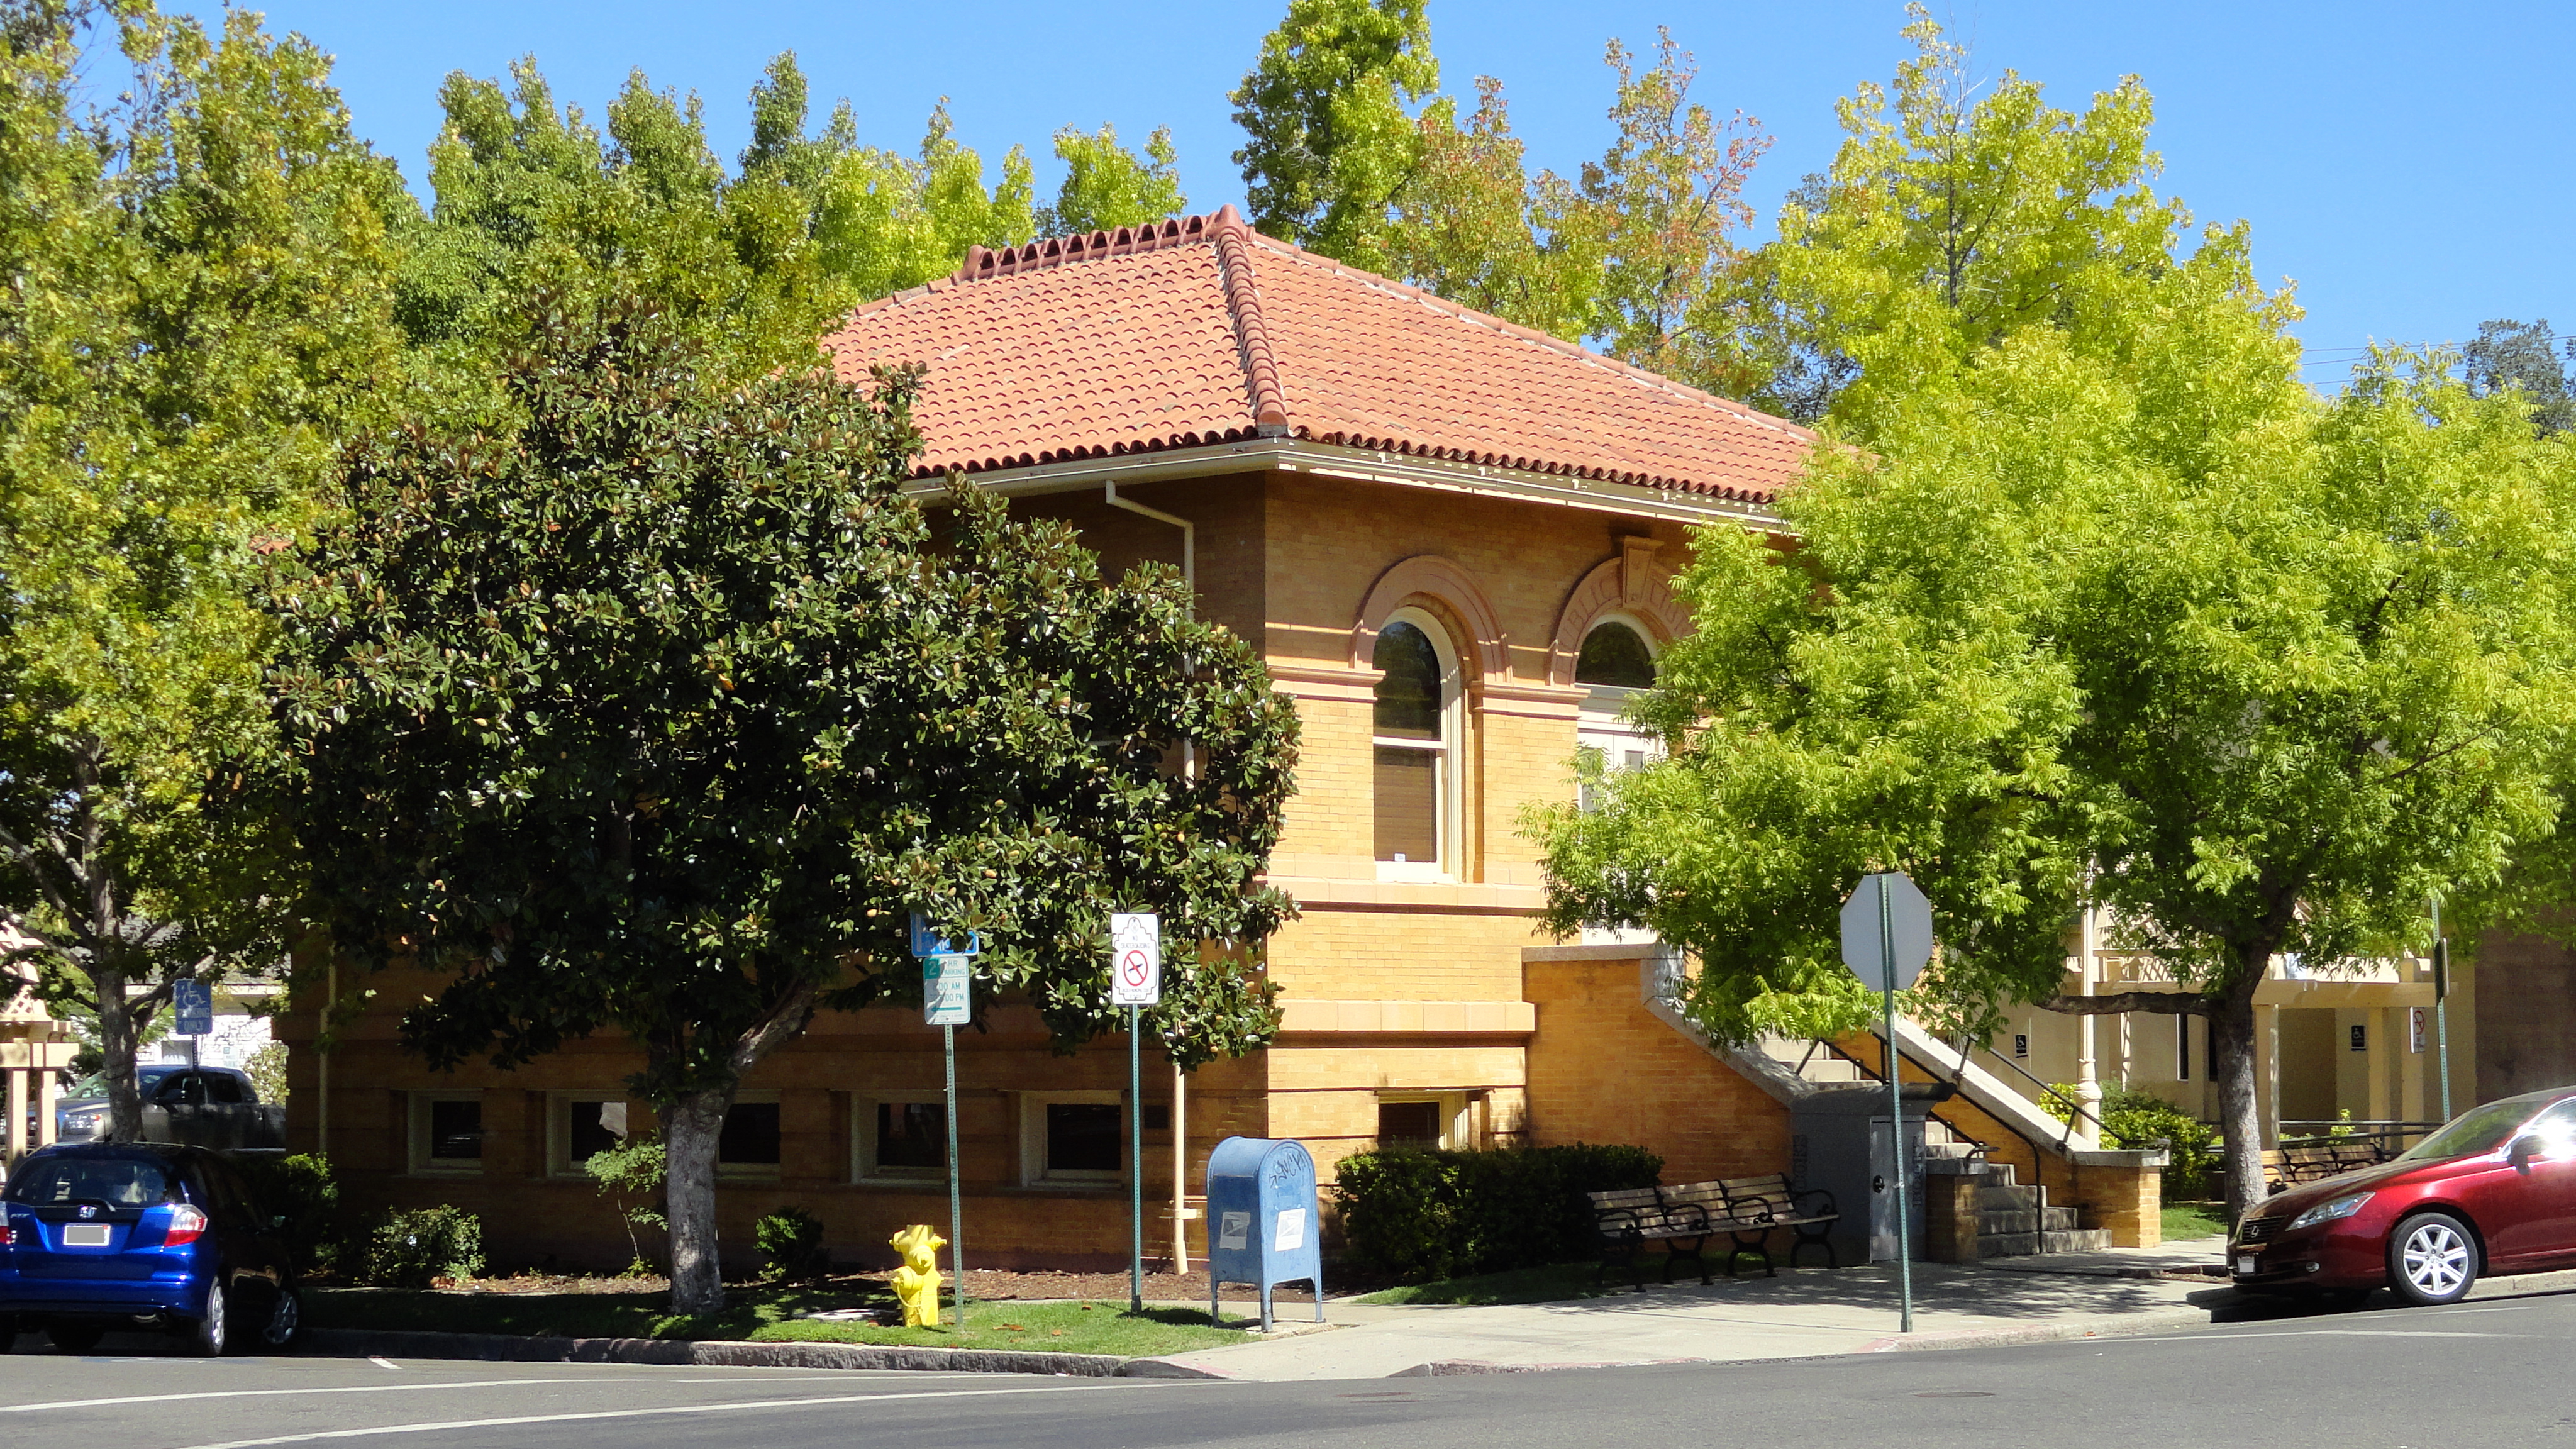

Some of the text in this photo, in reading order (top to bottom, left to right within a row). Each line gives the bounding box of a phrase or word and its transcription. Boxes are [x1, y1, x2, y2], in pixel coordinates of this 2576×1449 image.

[928, 960, 936, 975] 2
[951, 982, 961, 990] AM
[955, 992, 965, 1001] PM
